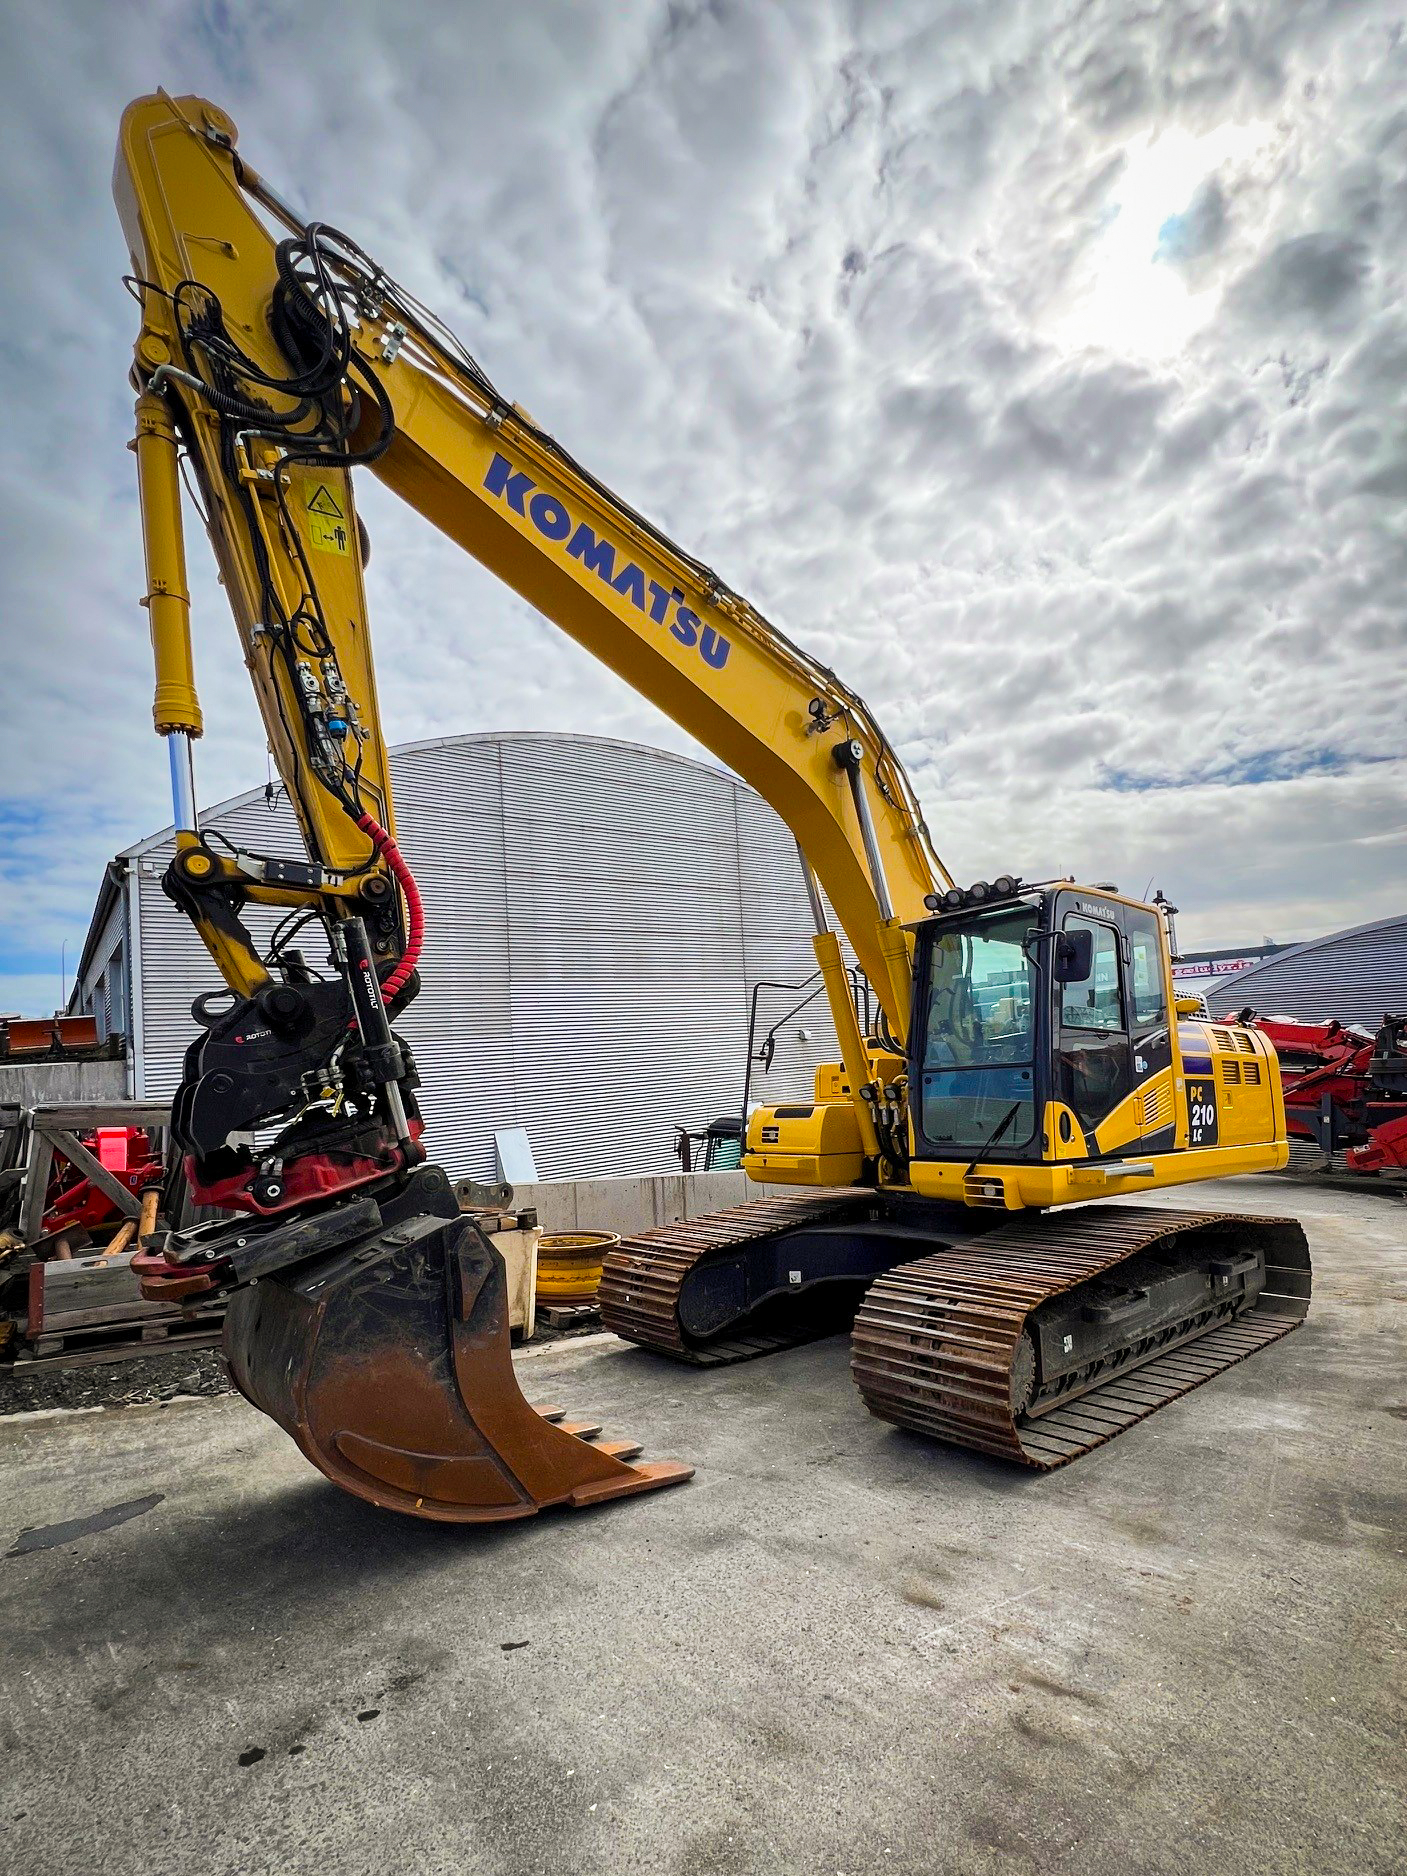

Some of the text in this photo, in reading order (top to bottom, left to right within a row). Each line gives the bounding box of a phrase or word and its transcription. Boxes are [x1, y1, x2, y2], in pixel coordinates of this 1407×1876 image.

[482, 451, 731, 670] KOMATSU
[1082, 902, 1115, 920] KOMATSU
[363, 971, 379, 1010] ROTOTILT
[245, 1029, 272, 1041] ROTOTI
[1190, 1085, 1203, 1102] PC
[1191, 1104, 1214, 1126] 210
[1192, 1128, 1203, 1142] LC
